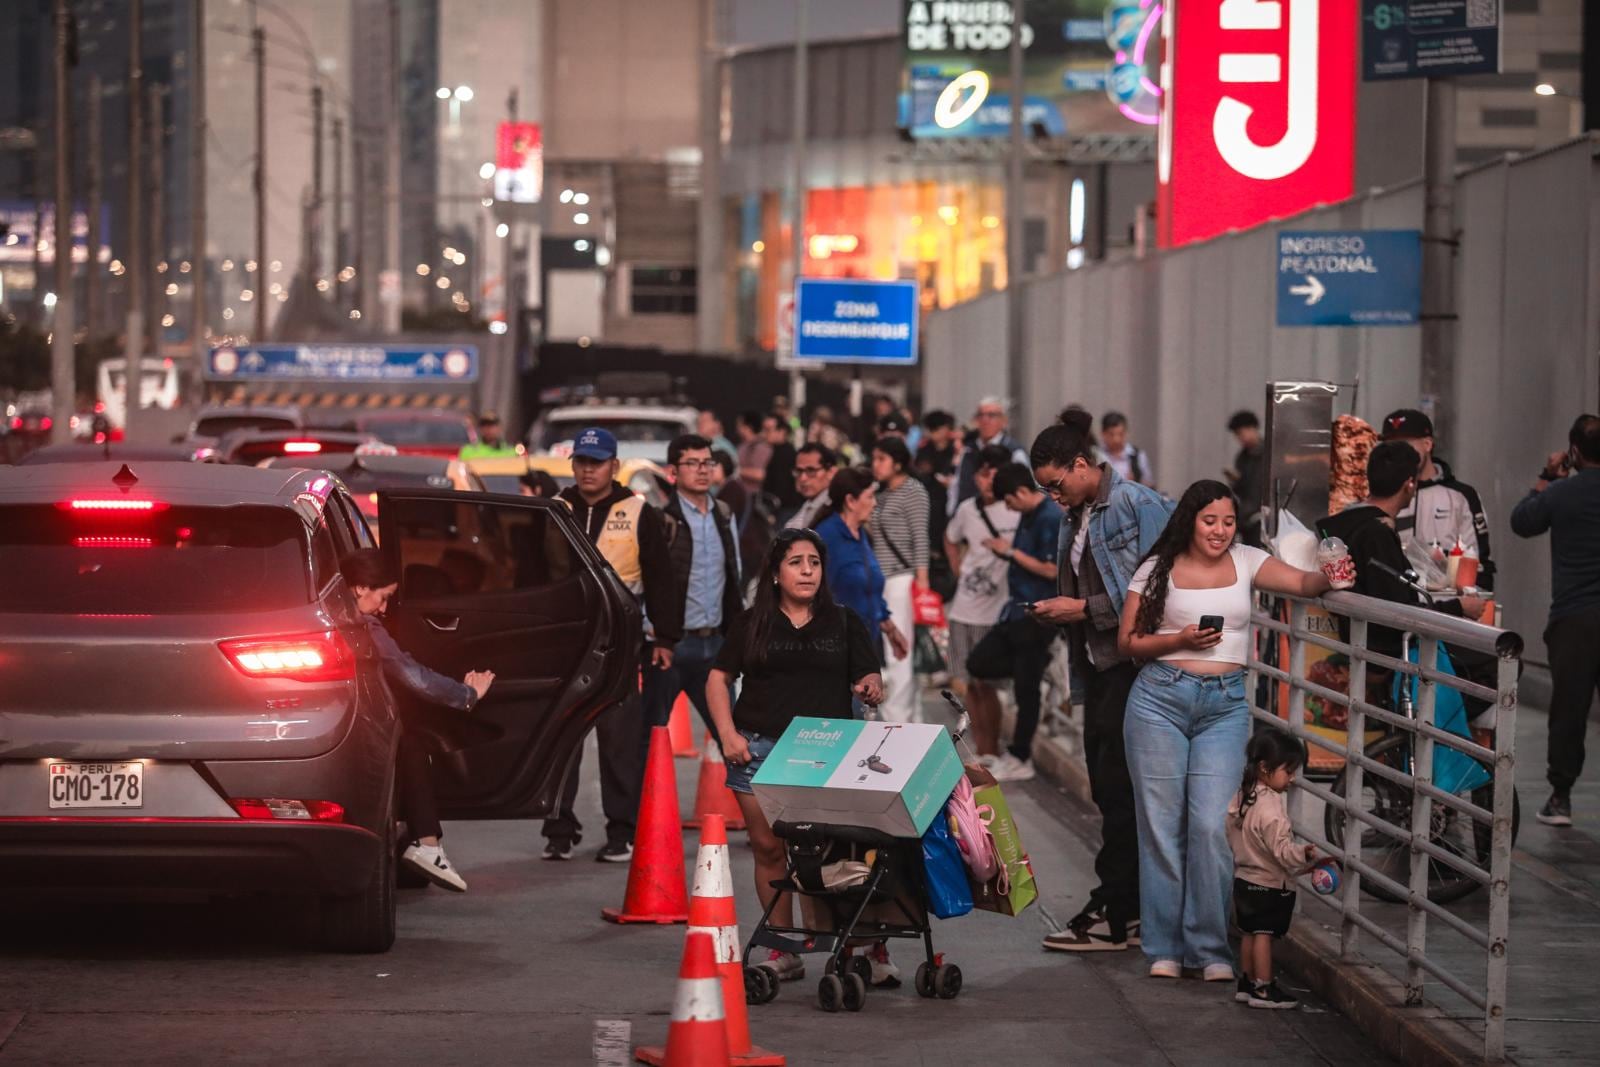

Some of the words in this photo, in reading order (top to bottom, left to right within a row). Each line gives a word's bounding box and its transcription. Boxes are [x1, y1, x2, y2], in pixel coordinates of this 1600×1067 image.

[931, 0, 1015, 23] PRUEB
[907, 23, 948, 50] DE
[1280, 236, 1366, 254] INGRESO
[1280, 255, 1379, 274] PEATONAL
[606, 522, 632, 531] LIMA
[797, 728, 843, 742] infanti
[79, 764, 113, 775] PERU
[52, 773, 140, 802] CMO-178
